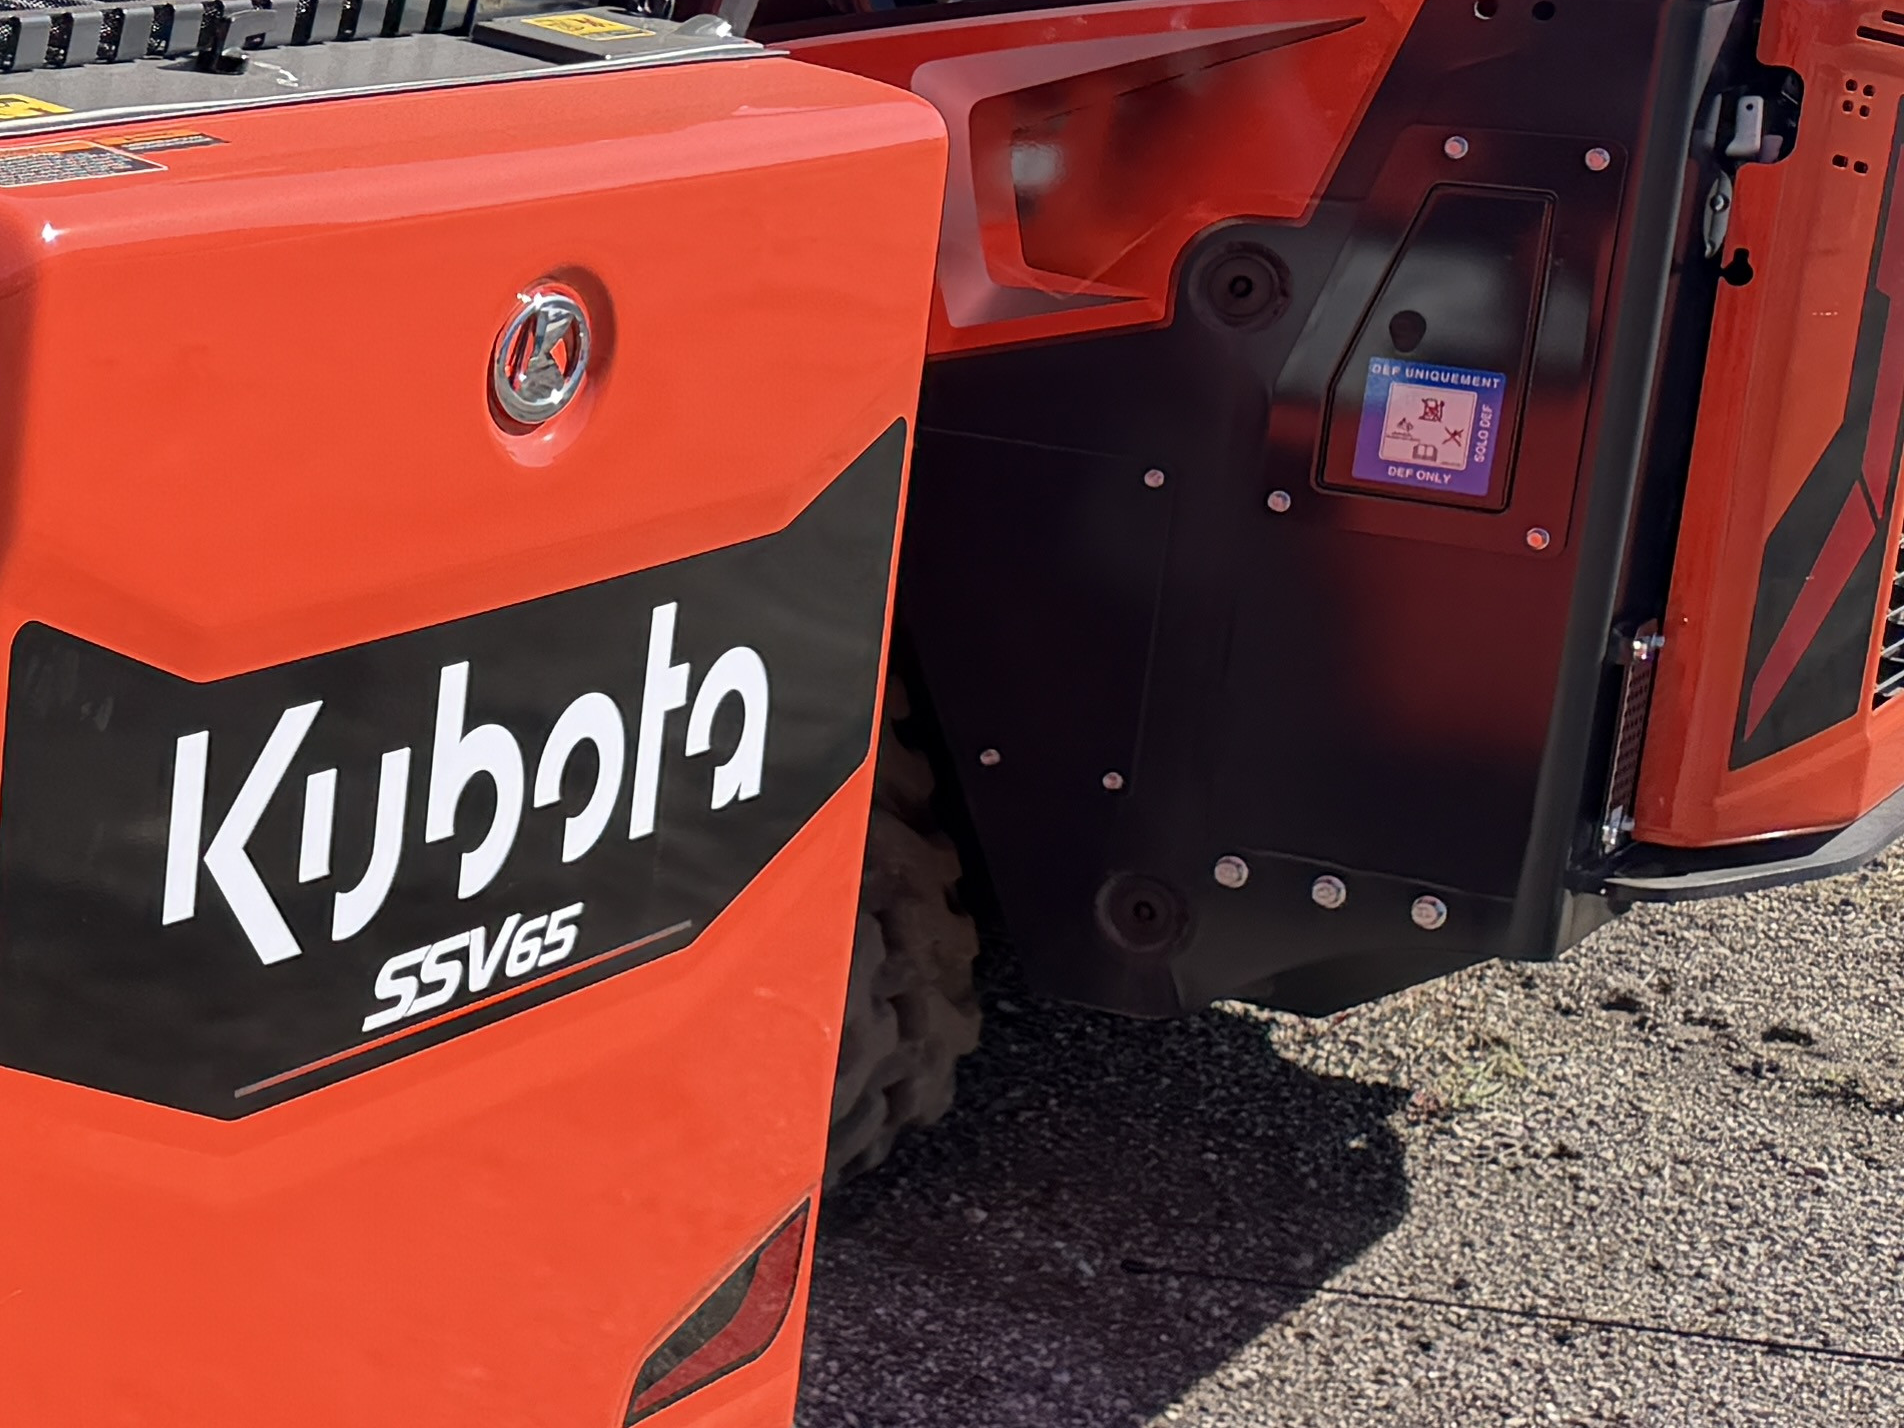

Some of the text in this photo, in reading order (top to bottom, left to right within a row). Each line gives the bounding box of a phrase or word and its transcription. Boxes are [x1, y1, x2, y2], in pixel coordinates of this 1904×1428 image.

[1371, 362, 1502, 390] DEF UNIQUEMENT
[1473, 403, 1494, 464] SOLO DEF
[1387, 465, 1452, 486] DEF ONLY
[162, 600, 769, 965] Kubota
[362, 901, 585, 1033] SSV65
